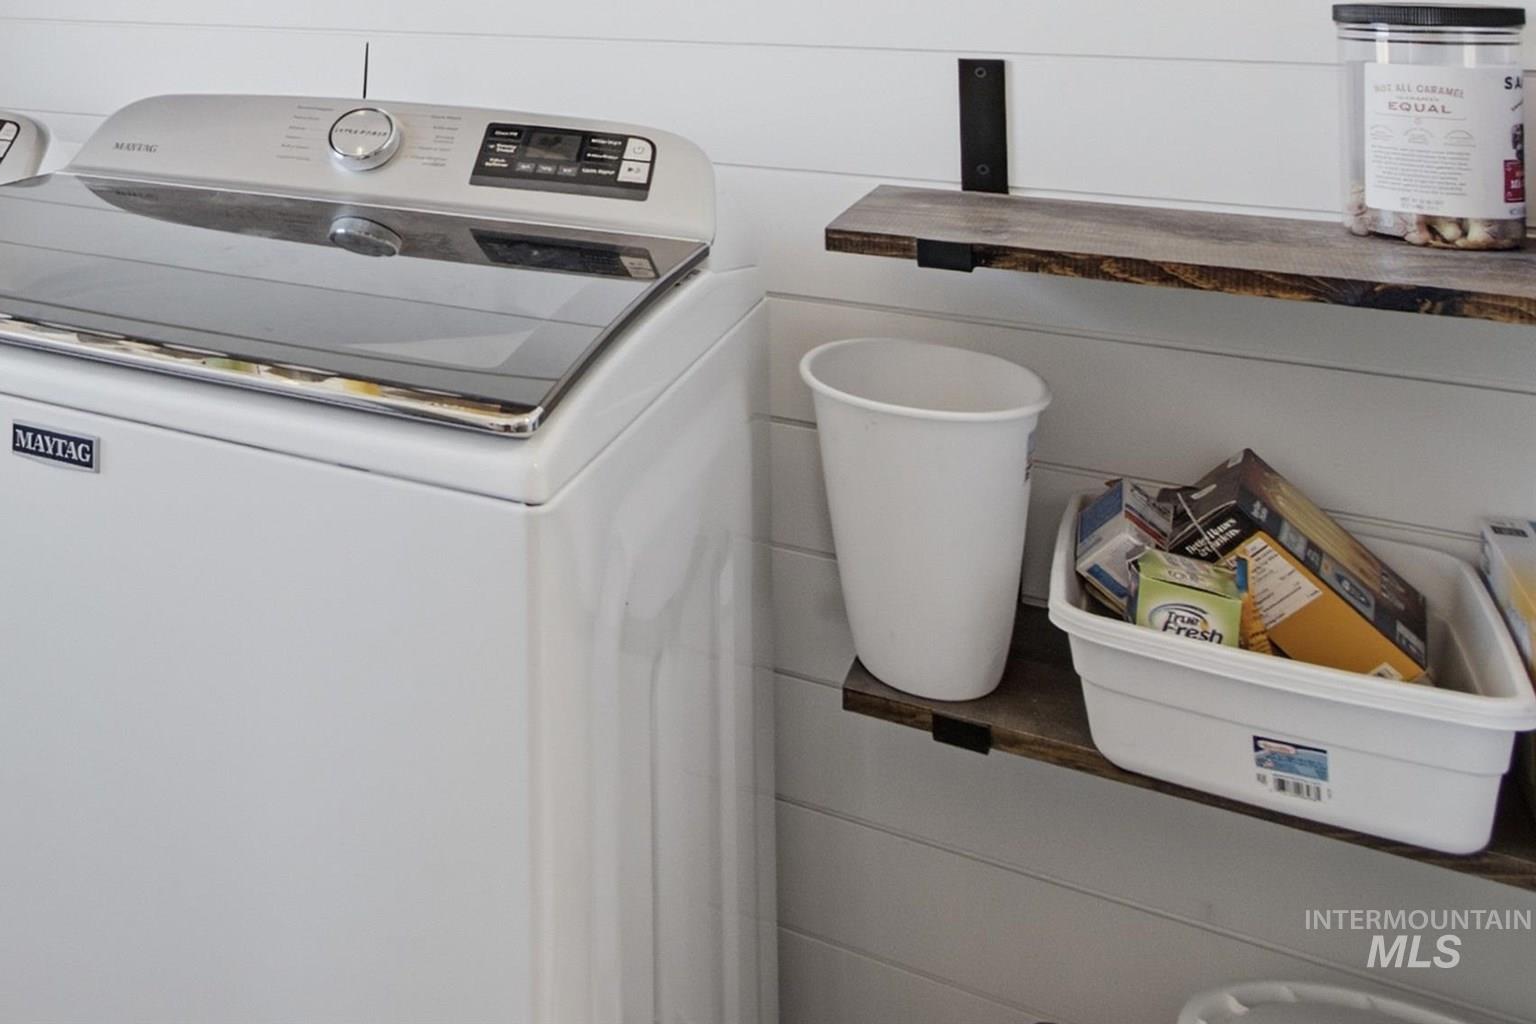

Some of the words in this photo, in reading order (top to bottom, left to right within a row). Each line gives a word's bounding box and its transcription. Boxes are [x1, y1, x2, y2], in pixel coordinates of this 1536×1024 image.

[1388, 101, 1452, 114] EQUAL
[15, 428, 91, 463] MAYTAG
[1168, 611, 1199, 625] True
[1162, 620, 1224, 644] Fresh
